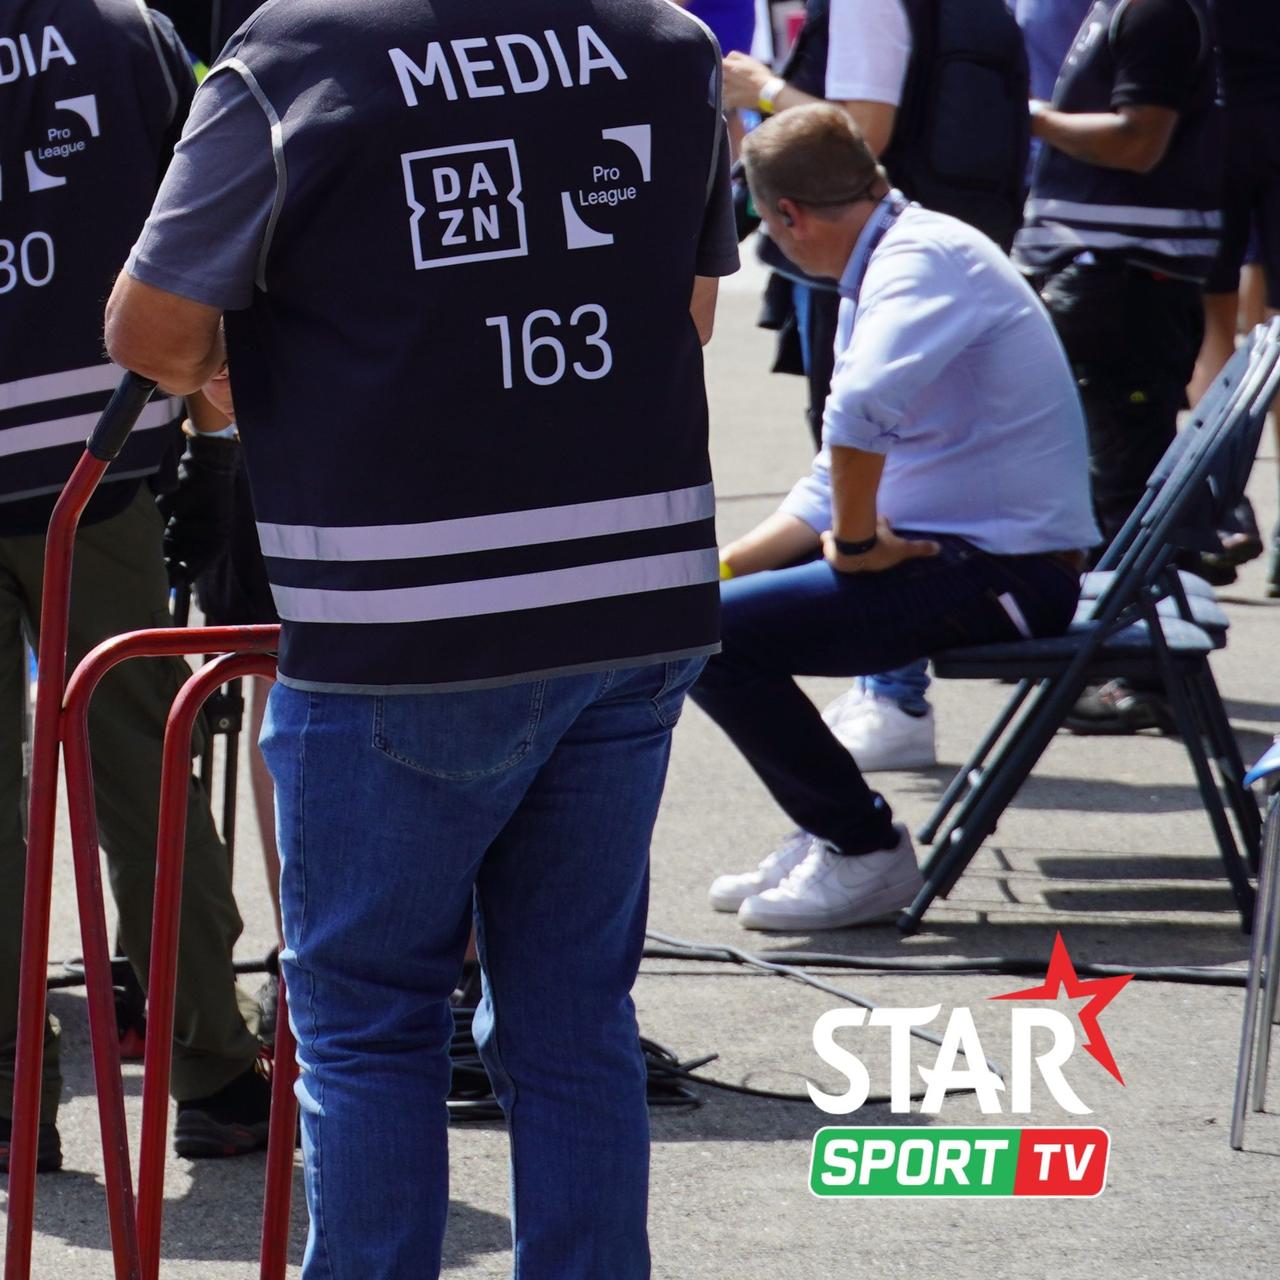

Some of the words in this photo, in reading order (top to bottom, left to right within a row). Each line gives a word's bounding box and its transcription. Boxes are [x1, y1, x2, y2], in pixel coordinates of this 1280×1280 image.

[388, 24, 627, 107] MEDIA
[38, 139, 86, 160] League
[47, 126, 71, 142] Pro
[432, 162, 498, 203] DA
[592, 165, 620, 183] Pro
[579, 184, 637, 206] League
[439, 204, 500, 246] ZN
[485, 303, 613, 389] 163
